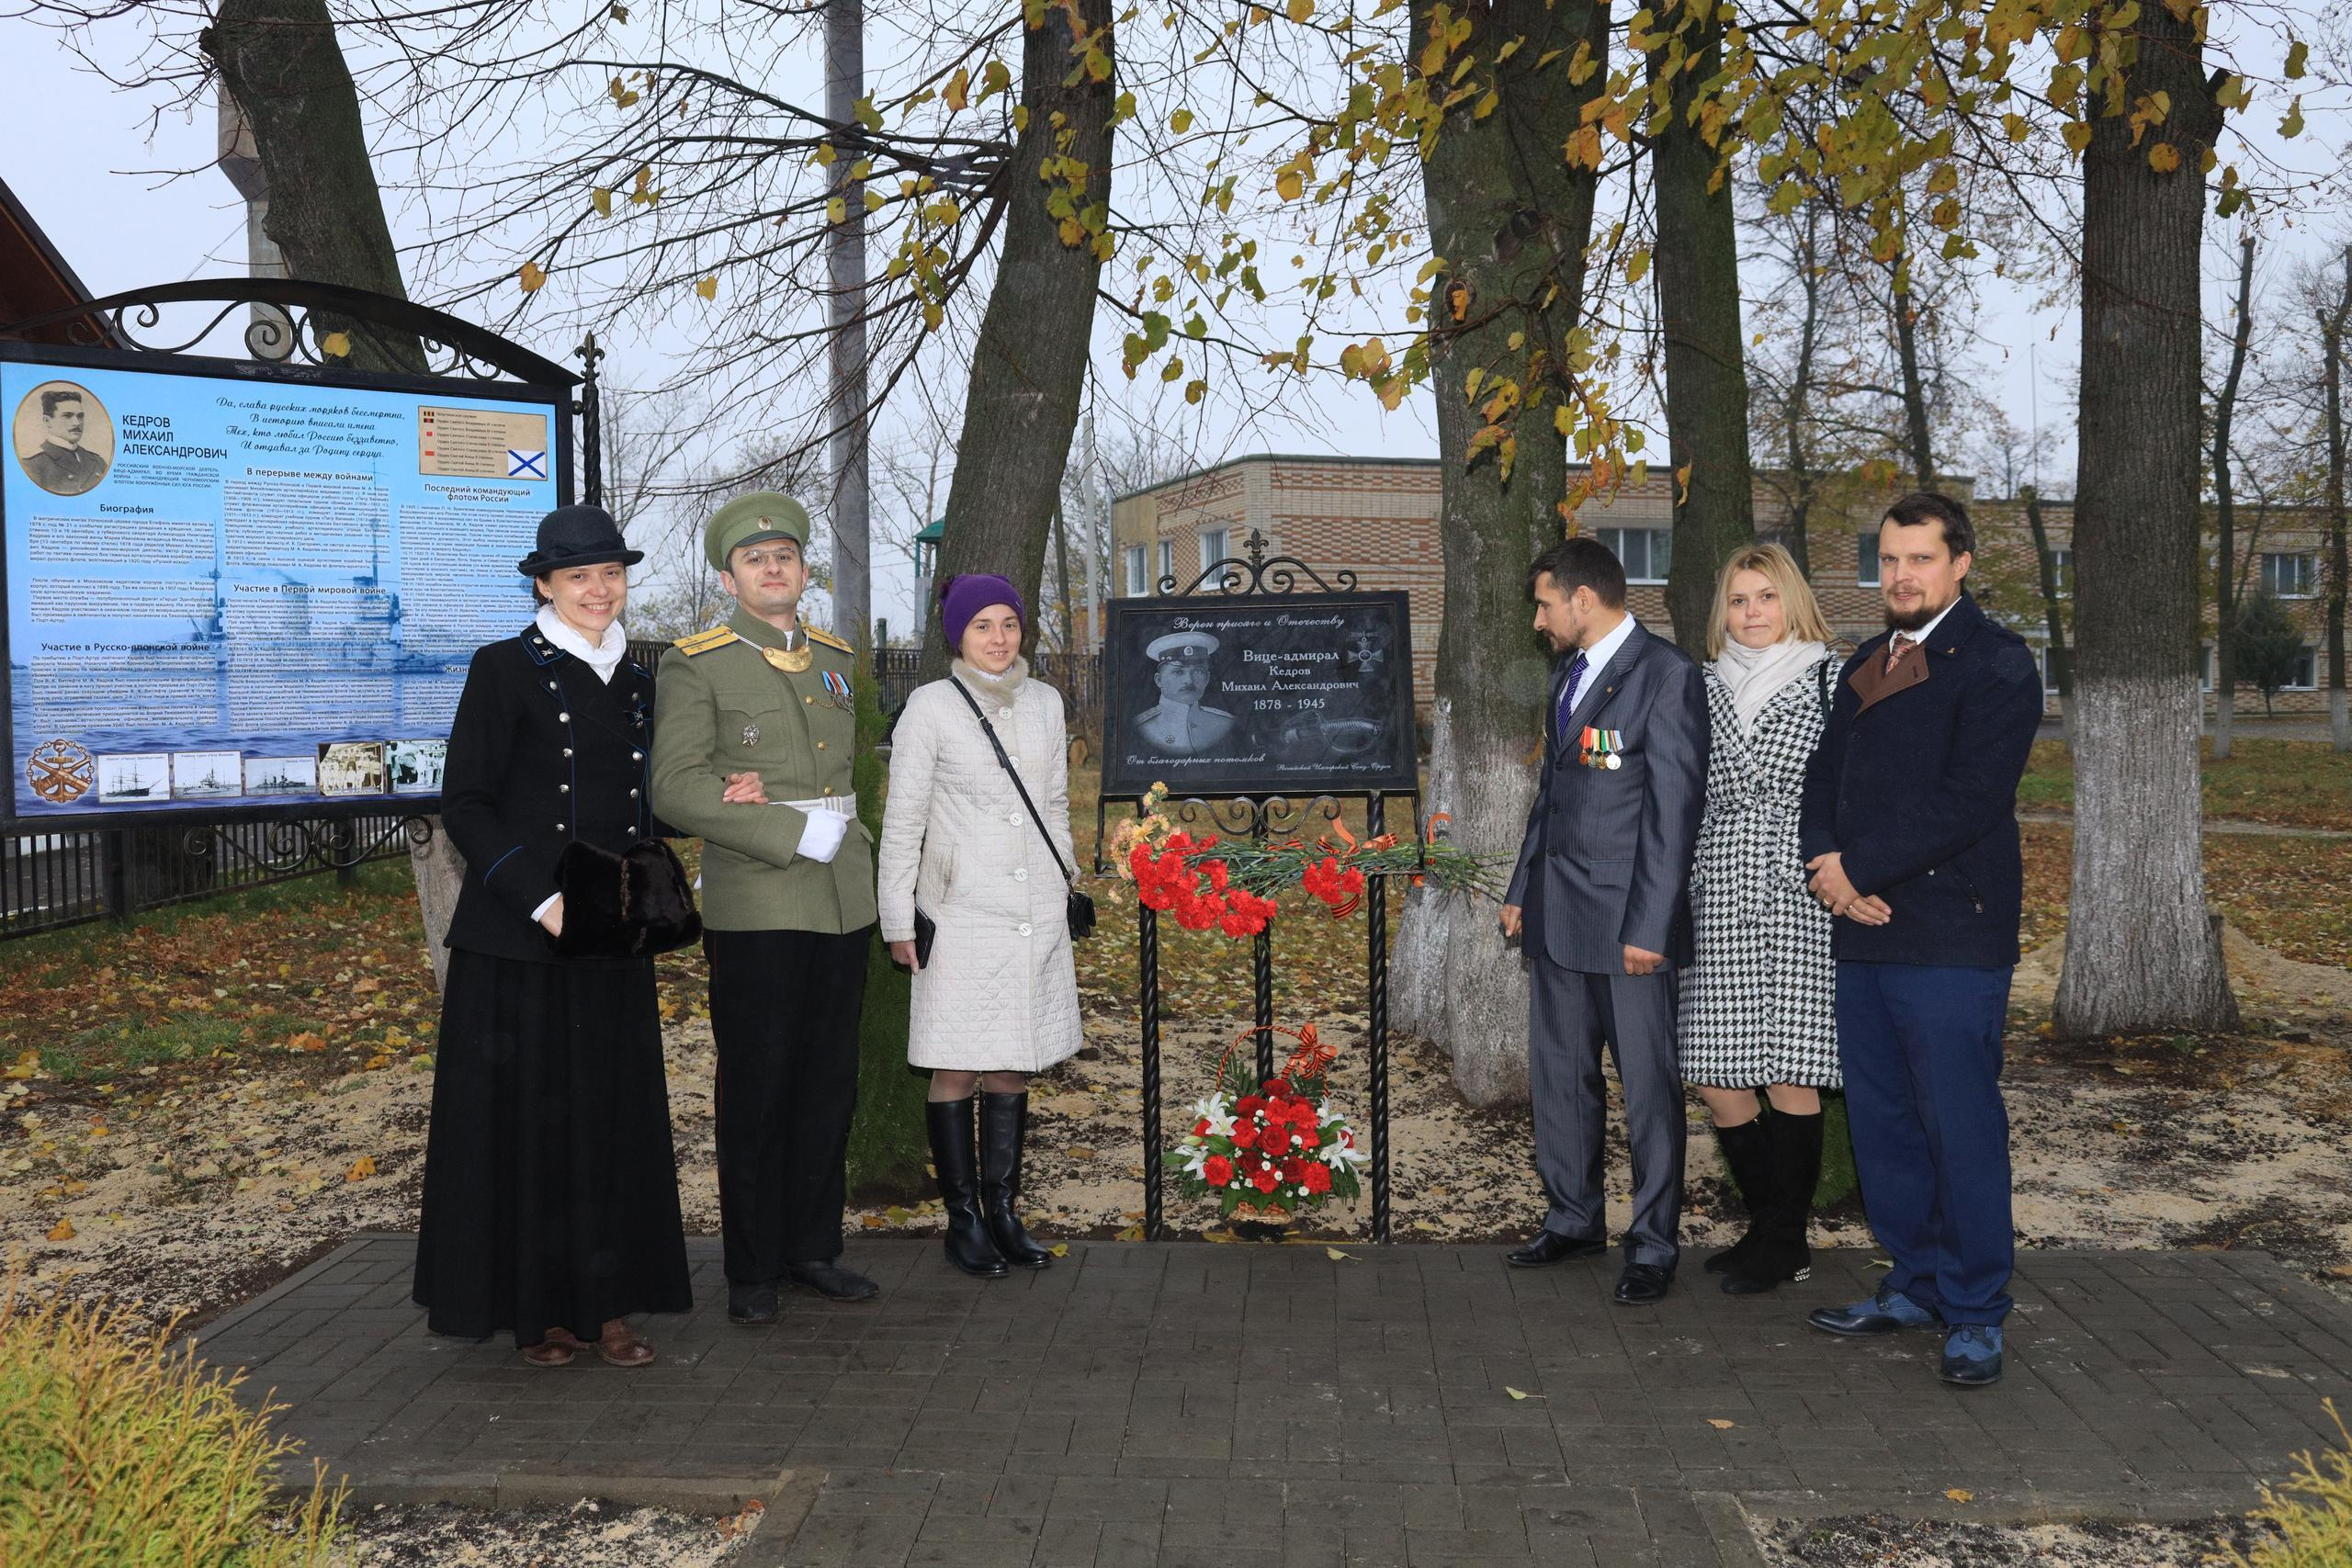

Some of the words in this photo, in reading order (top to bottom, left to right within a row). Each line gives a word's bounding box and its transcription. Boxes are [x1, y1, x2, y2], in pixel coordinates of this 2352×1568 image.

[217, 397, 235, 408] Да,
[239, 400, 266, 409] слава
[270, 402, 307, 412] русских
[309, 406, 349, 415] моряков
[352, 407, 404, 420] бессмертна,
[123, 415, 171, 428] КЕДРОВ
[250, 413, 259, 423] В
[263, 417, 305, 426] историю
[309, 418, 345, 428] вписали
[123, 430, 174, 442] МИХАИЛ
[226, 425, 250, 437] Тех,
[253, 428, 271, 437] кто
[274, 430, 305, 439] любил
[307, 431, 344, 441] Россию
[347, 434, 399, 446] беззаветно,
[123, 444, 228, 459] АЛЕКСАНДРОВИЧ
[241, 441, 252, 450] И
[254, 443, 296, 452] отдавал
[298, 446, 311, 456] за
[312, 445, 350, 457] Родину
[247, 467, 253, 476] В
[255, 469, 301, 478] перерыве
[304, 472, 333, 480] между
[335, 473, 373, 481] войнами
[424, 483, 470, 493] Последний
[473, 487, 530, 497] командующий
[447, 491, 479, 502] флотом
[481, 494, 509, 503] России
[99, 503, 154, 514] Биография
[233, 584, 270, 593] Участие
[281, 584, 314, 595] Первой
[318, 586, 356, 595] мировой
[360, 586, 386, 594] войне
[1173, 617, 1214, 632] Верен
[1216, 619, 1261, 632] присяге
[1277, 614, 1345, 629] Отечеству
[41, 643, 81, 652] Участие
[94, 643, 176, 652] Русско-японской
[1243, 649, 1340, 663] Вице-адмирал
[445, 665, 470, 673] Жизн
[1269, 666, 1311, 678] Кедров
[1222, 682, 1267, 692] Михаил
[1272, 680, 1360, 692] Александрович
[1253, 700, 1282, 710] 1878
[1297, 698, 1326, 709] 1945
[1126, 754, 1145, 764] От
[1147, 756, 1211, 768] благодарных
[1214, 753, 1266, 763] потомков
